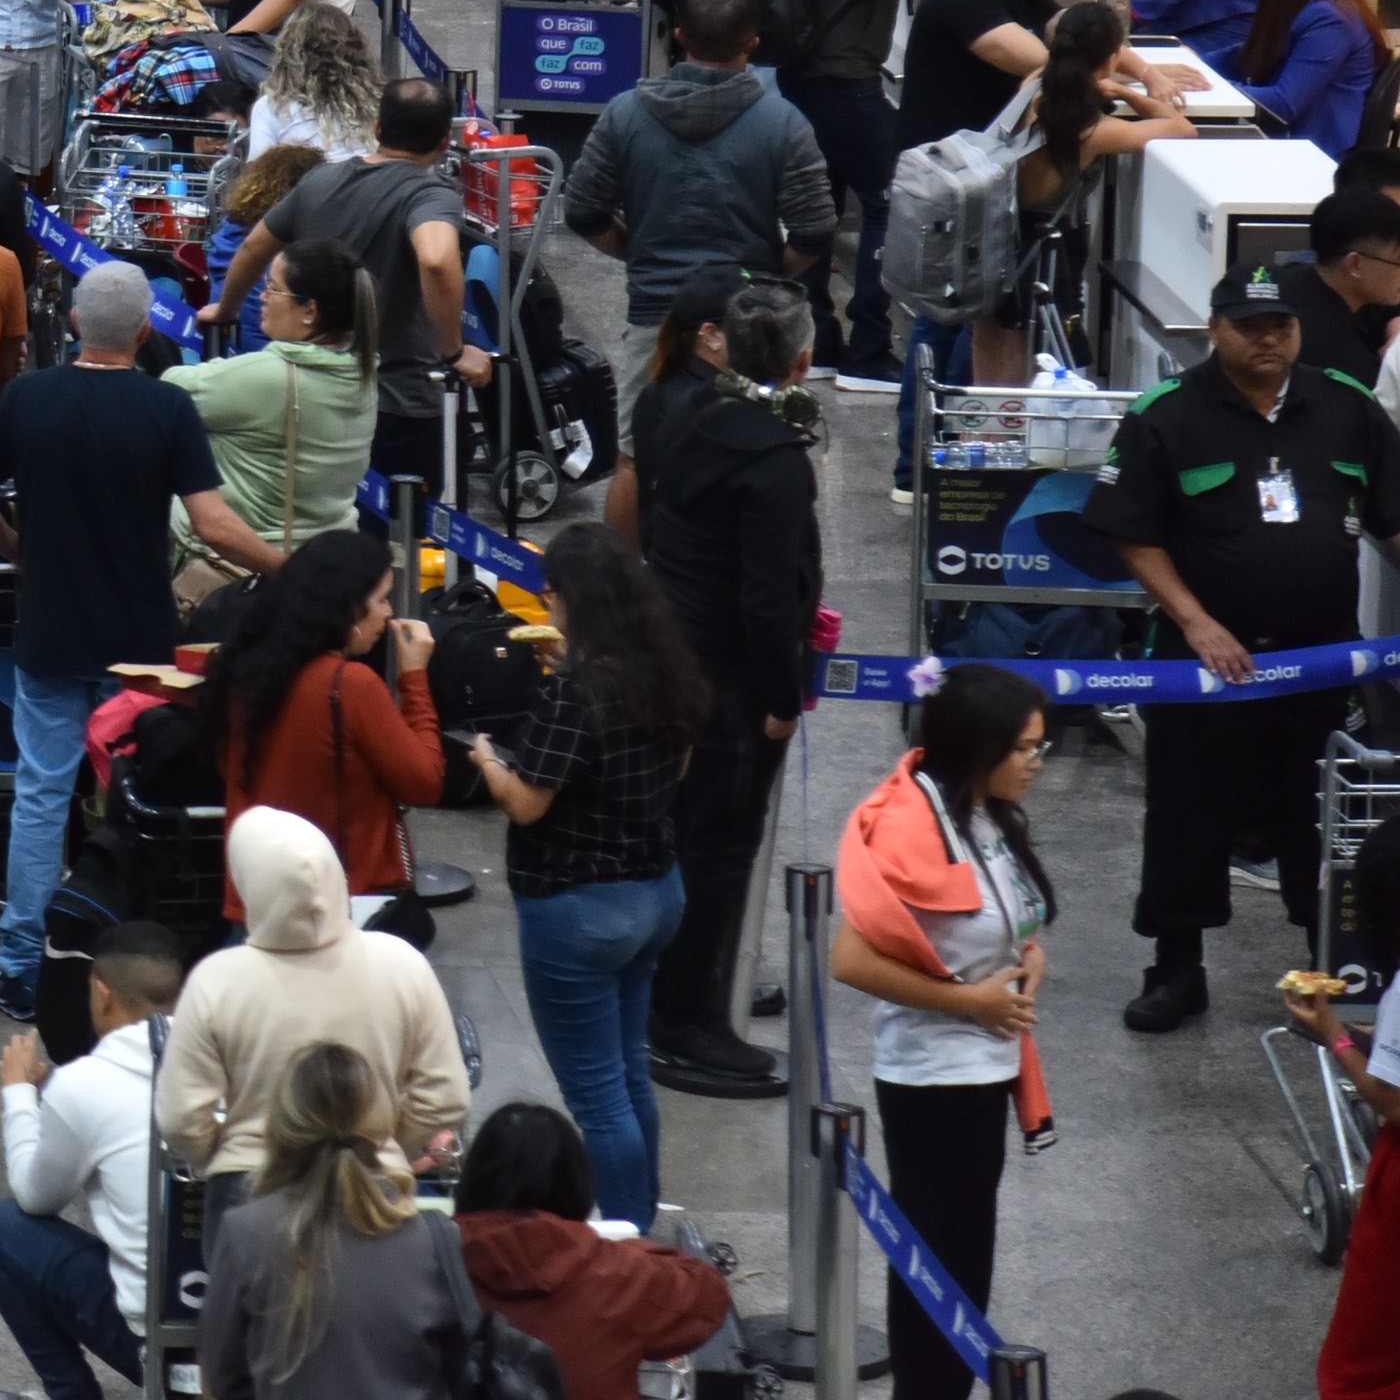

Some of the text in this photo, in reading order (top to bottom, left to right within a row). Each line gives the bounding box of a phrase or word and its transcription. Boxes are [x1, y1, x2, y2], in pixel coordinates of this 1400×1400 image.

[542, 17, 593, 32] O Brasil
[541, 39, 599, 50] que faz
[541, 58, 602, 71] faz com
[1087, 672, 1155, 688] decolar
[1242, 664, 1302, 684] ecolar
